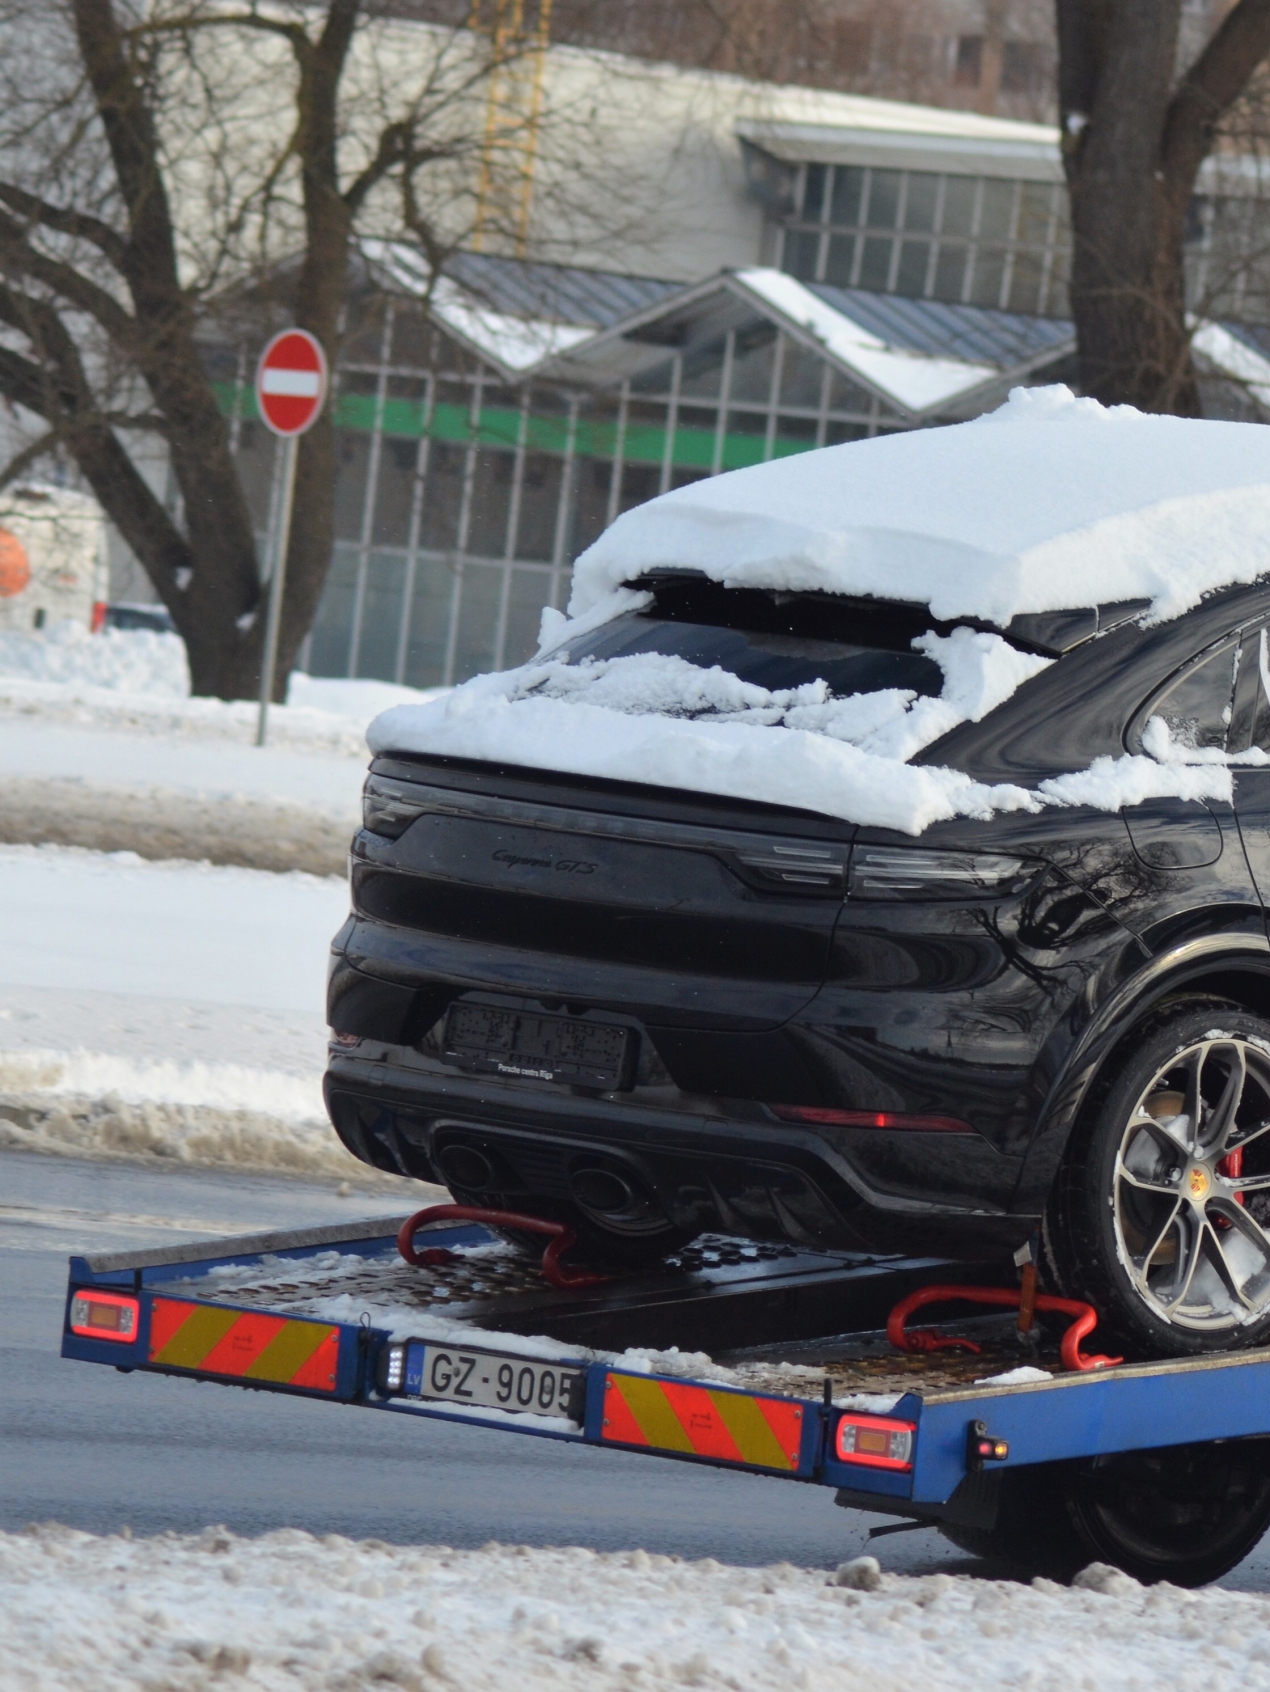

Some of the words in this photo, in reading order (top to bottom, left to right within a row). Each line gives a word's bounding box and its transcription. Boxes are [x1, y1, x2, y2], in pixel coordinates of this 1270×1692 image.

[492, 849, 552, 869] Cayenne
[554, 860, 599, 874] GTS
[498, 1063, 520, 1074] Porsche
[407, 1373, 421, 1385] LV
